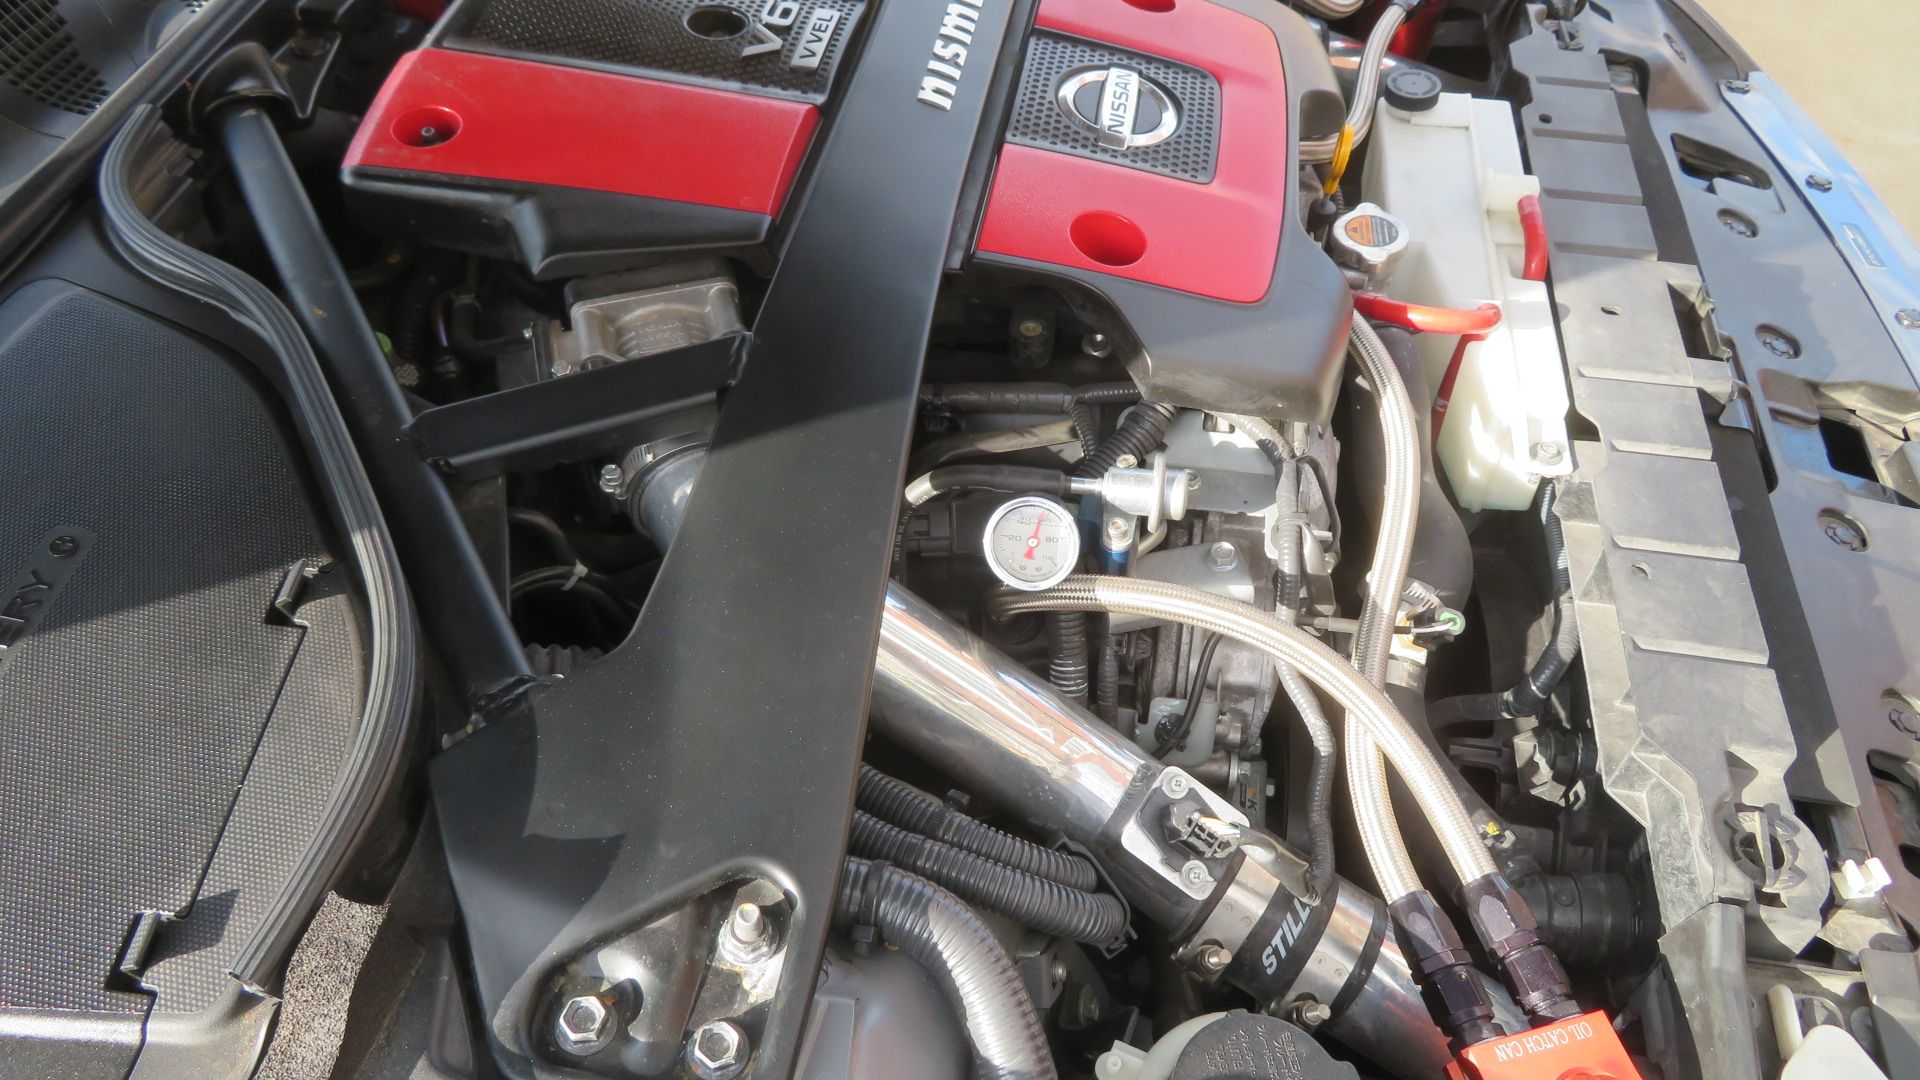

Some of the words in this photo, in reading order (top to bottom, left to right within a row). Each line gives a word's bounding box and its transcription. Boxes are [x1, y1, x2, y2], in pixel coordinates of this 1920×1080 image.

[742, 0, 800, 57] V6
[799, 14, 834, 59] VVEL
[917, 0, 984, 111] nism
[1106, 71, 1134, 134] NISSAN
[1262, 897, 1312, 975] STILL
[1493, 1040, 1524, 1062] CAN
[1523, 1028, 1569, 1054] CATCH
[1567, 1022, 1593, 1041] OIL
